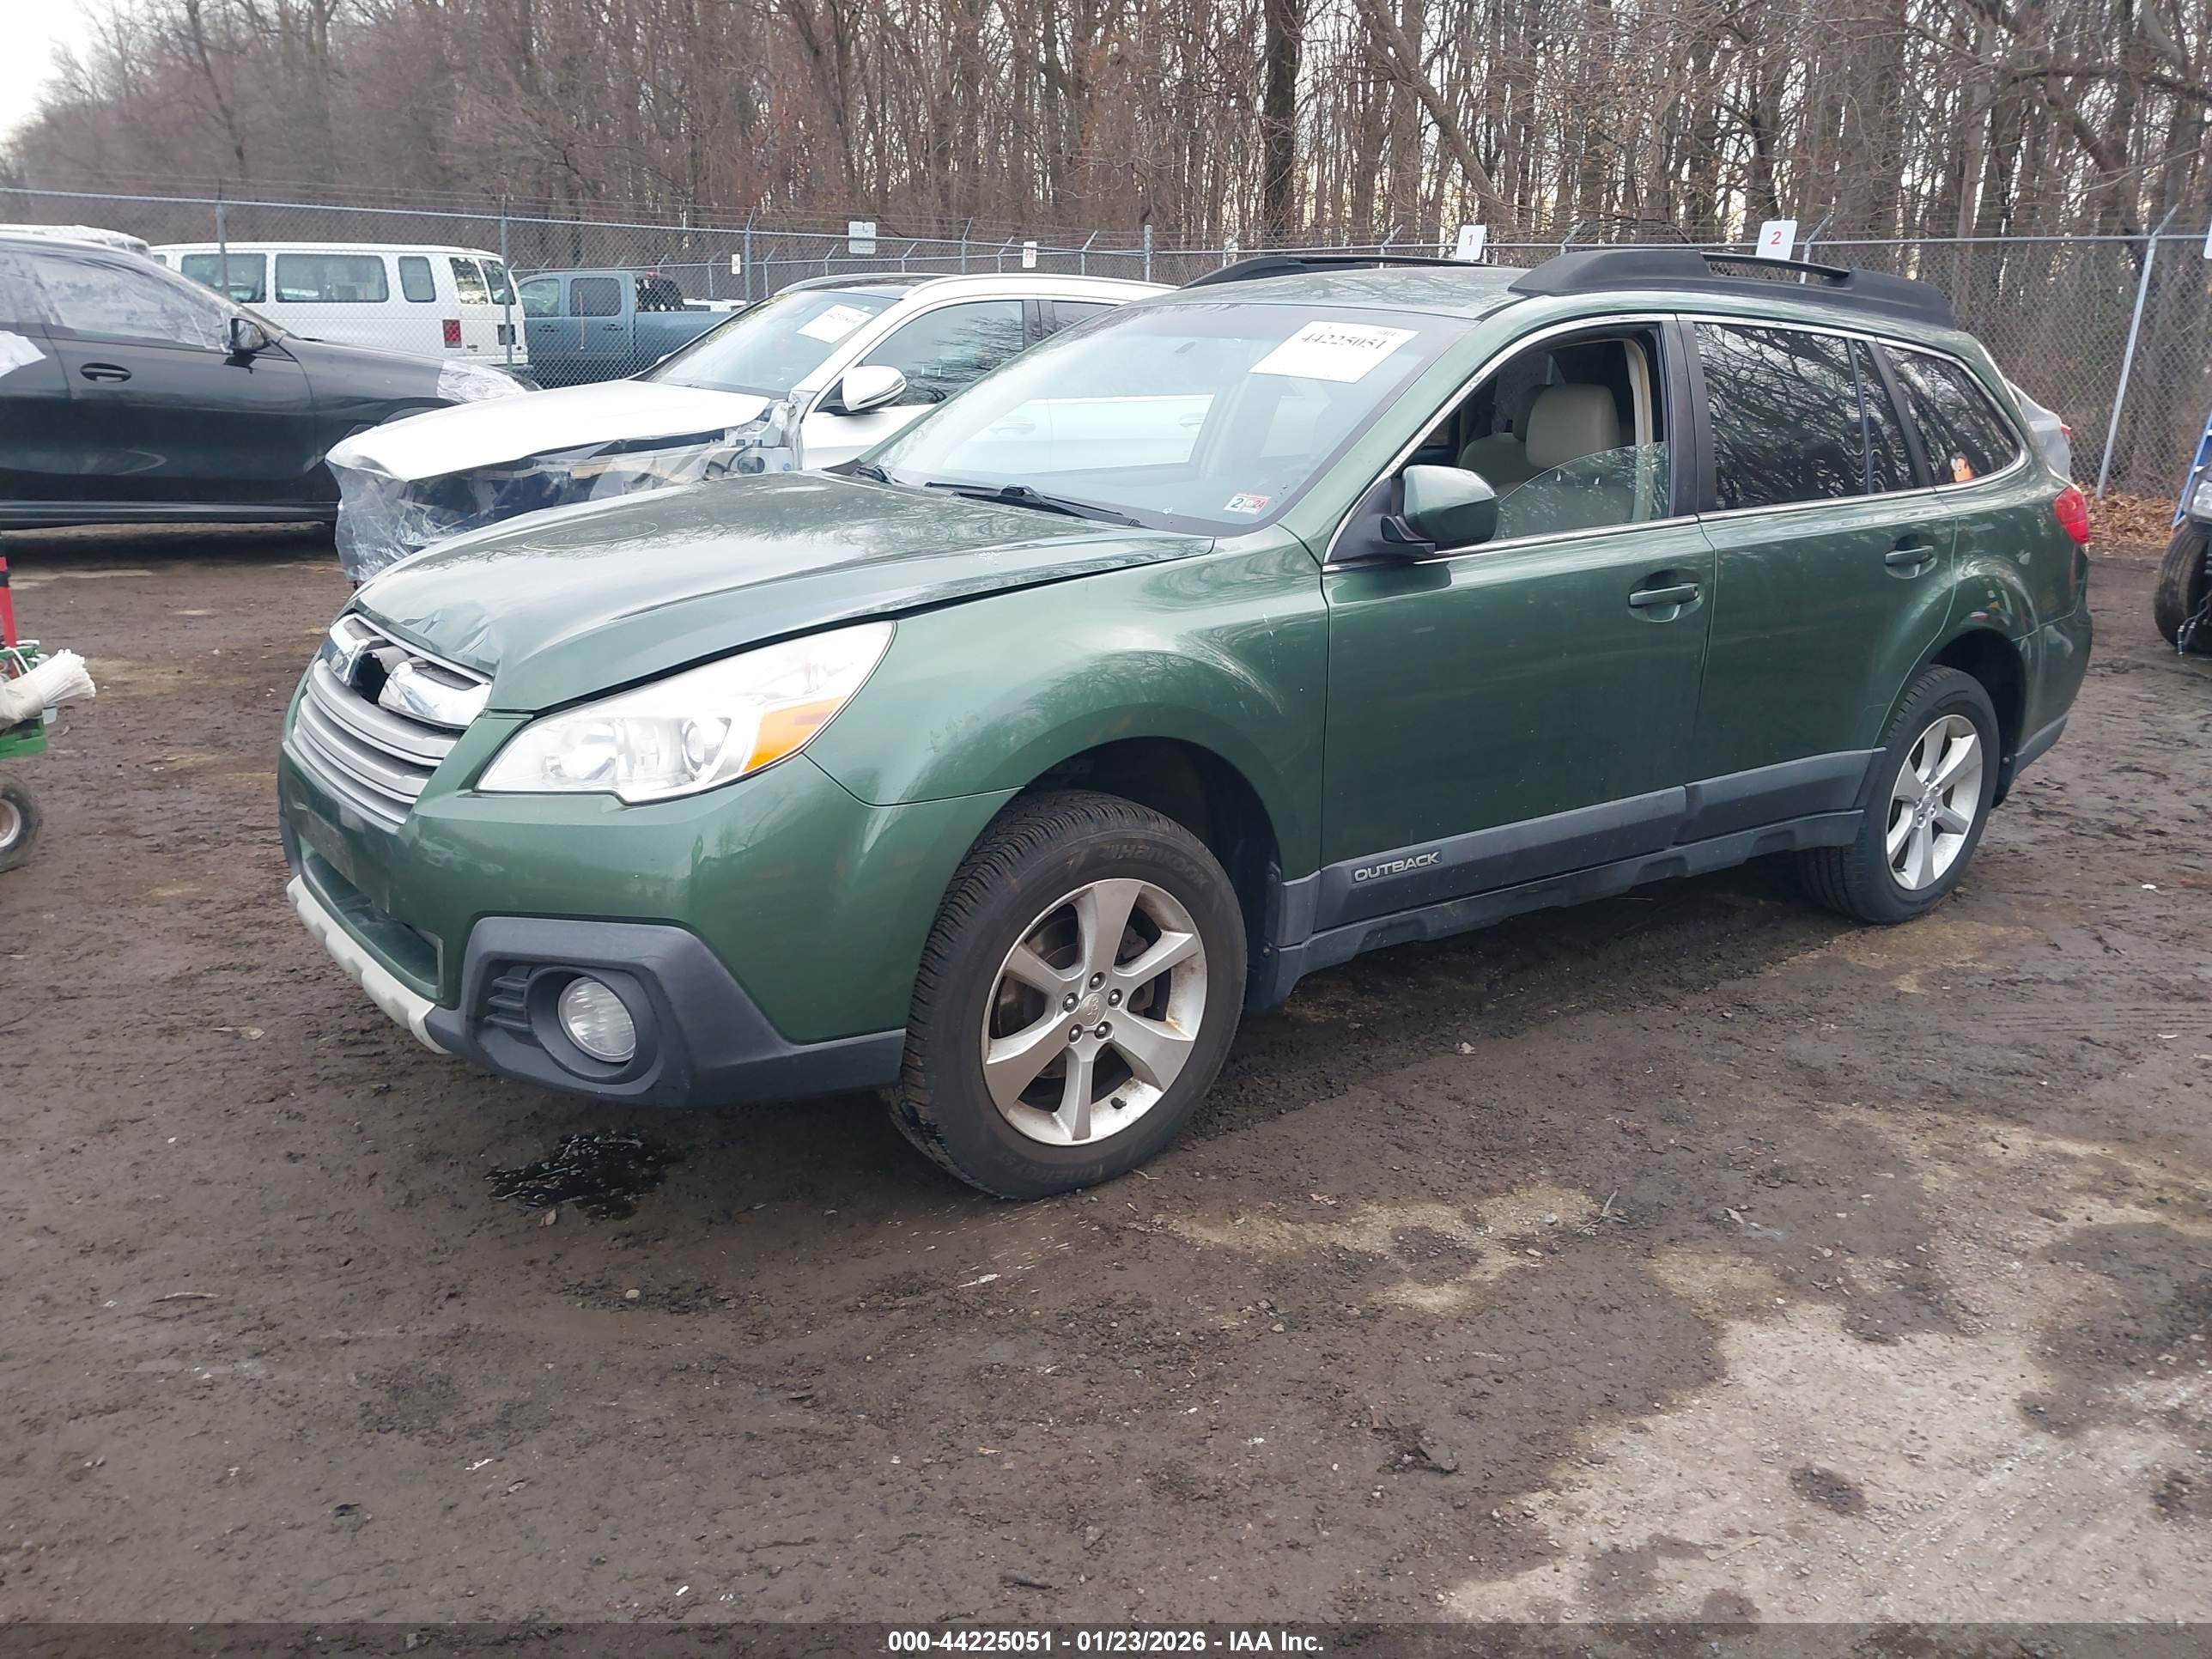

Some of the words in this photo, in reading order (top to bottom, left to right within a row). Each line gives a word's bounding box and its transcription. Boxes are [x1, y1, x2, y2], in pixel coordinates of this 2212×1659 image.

[1468, 234, 1474, 246] 1
[1771, 231, 1782, 245] 2
[1231, 497, 1244, 508] 2
[1354, 851, 1440, 882] OUTBACK
